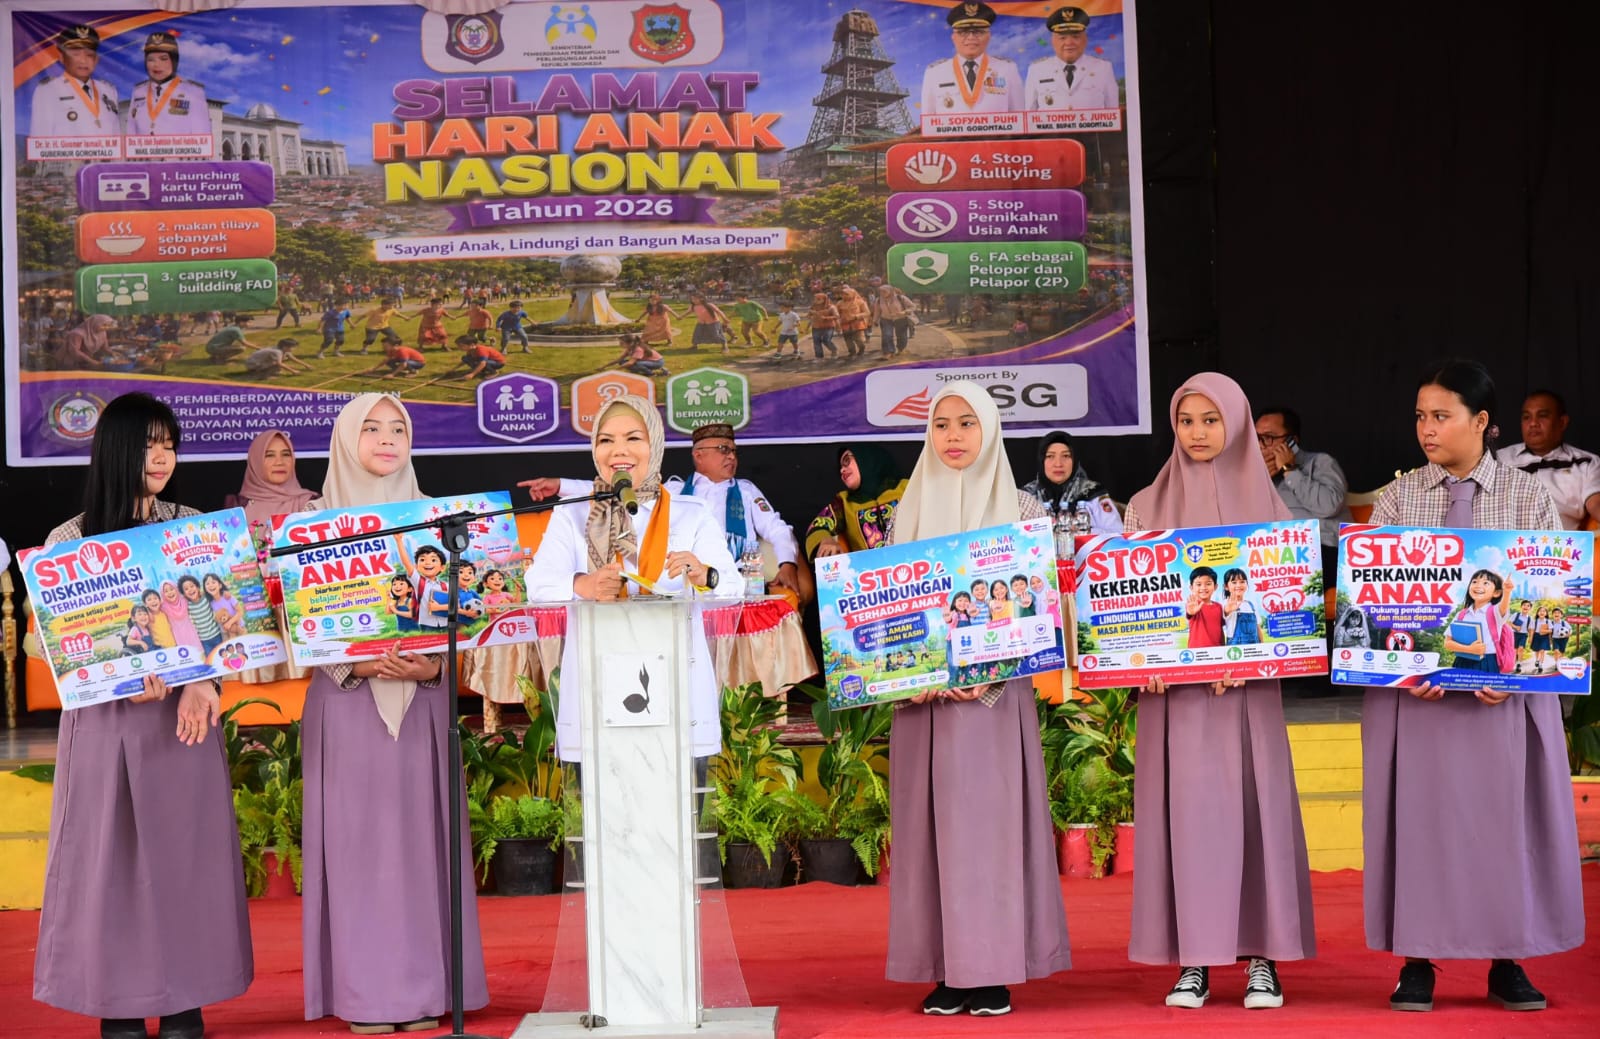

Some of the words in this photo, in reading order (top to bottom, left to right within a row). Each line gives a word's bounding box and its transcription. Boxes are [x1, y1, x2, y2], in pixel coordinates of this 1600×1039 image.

[392, 71, 760, 120] SELAMAT
[950, 116, 989, 125] SOFYAN
[1046, 114, 1076, 122] TONNY
[1090, 112, 1118, 121] JUNUS
[372, 114, 561, 161] HARI
[573, 112, 785, 151] ANAK
[970, 154, 986, 164] 4.
[992, 153, 1033, 166] Stop
[161, 172, 171, 181] 1.
[175, 171, 240, 182] launching
[384, 152, 781, 203] NASIONAL
[970, 167, 1052, 181] Bulliying
[200, 182, 242, 191] Forum
[161, 193, 193, 203] anak
[197, 192, 244, 202] Daerah
[485, 201, 584, 221] Tahun
[594, 199, 674, 217] 2026
[968, 200, 982, 210] 5.
[987, 199, 1024, 211] Stop
[968, 212, 1058, 223] Pernikahan
[158, 222, 169, 231] 2.
[174, 222, 217, 231] makan
[221, 221, 260, 231] tiliaya
[968, 225, 1002, 235] Usia
[1007, 224, 1048, 235] Anak
[158, 232, 228, 244] sebanyak
[385, 242, 455, 256] “Sayangi
[459, 239, 505, 252] Anak,
[509, 237, 580, 250] Lindungi
[584, 236, 614, 248] dan
[619, 235, 678, 249] Bangun
[681, 234, 721, 246] Masa
[725, 233, 780, 247] Depan”
[158, 246, 187, 255] 500
[191, 244, 227, 256] porsi
[969, 252, 984, 262] 6.
[989, 252, 1009, 262] FA
[1014, 251, 1074, 264] sebagai
[161, 272, 174, 281] 3.
[179, 269, 238, 280] capasity
[969, 264, 1030, 277] Pelopor
[1034, 264, 1062, 275] dan
[179, 281, 242, 293] buildding
[246, 280, 273, 289] FAD
[969, 277, 1030, 289] Pelapor
[1035, 276, 1069, 289] (2P)
[935, 372, 998, 383] Sponsort
[1001, 370, 1019, 381] By
[175, 393, 313, 405] PEMBERBERDAYAAN
[985, 382, 1058, 409] SG
[172, 406, 272, 417] ERLINDUNGAN
[275, 405, 314, 415] ANAK
[490, 413, 547, 423] LINDUNGI
[676, 408, 741, 419] BERDAYAKAN
[246, 417, 337, 428] MASYARAKAT
[501, 423, 536, 432] ANAK
[161, 536, 191, 556] HARI
[194, 531, 228, 545] ANAK
[969, 540, 988, 551] HARI
[991, 534, 1016, 546] ANAK
[1247, 536, 1277, 548] HARI
[180, 545, 214, 558] NASIONAL
[297, 539, 387, 566] EKSPLOITASI
[970, 544, 1016, 560] NASIONAL
[1248, 546, 1310, 567] ANAK
[1351, 535, 1460, 566] STOP
[1543, 546, 1582, 561] ANAK
[35, 542, 130, 588] STOP
[189, 554, 212, 566] 2026
[1087, 543, 1177, 582] STOP
[301, 552, 393, 588] ANAK
[859, 561, 930, 592] STOP
[1250, 565, 1312, 579] NASIONAL
[1351, 567, 1462, 583] PERKAWINAN
[1530, 568, 1556, 576] 2026
[41, 567, 143, 605] DISKRIMINASI
[315, 584, 341, 595] biarkan
[343, 580, 370, 590] mereka
[1089, 573, 1182, 599] KEKERASAN
[1269, 579, 1290, 588] 2026
[51, 592, 107, 615] TERHADAP
[111, 583, 142, 599] ANAK
[310, 594, 341, 605] belajar,
[342, 587, 379, 599] bermain,
[838, 576, 952, 615] PERUNDUNGAN
[1356, 583, 1454, 604] ANAK
[309, 606, 323, 614] dan
[325, 600, 353, 611] meraih
[355, 595, 382, 606] impian
[1090, 594, 1149, 612] TERHADAP
[1152, 590, 1183, 605] ANAK
[63, 613, 85, 623] karena
[86, 608, 104, 617] setiap
[105, 603, 119, 611] anak
[852, 602, 909, 624] TERHADAP
[911, 596, 941, 610] ANAK
[1099, 612, 1136, 625] LINDUNGI
[1138, 610, 1155, 620] HAK
[1157, 608, 1174, 618] DAN
[1370, 606, 1399, 615] Dukung
[1401, 606, 1442, 615] pendidikan
[1413, 614, 1436, 622] depan
[889, 624, 913, 635] AMAN
[1097, 626, 1118, 636] MASA
[1121, 623, 1145, 633] DEPAN
[1147, 619, 1180, 631] MEREKA!
[877, 632, 902, 645] PENUH
[903, 628, 925, 639] KASIH
